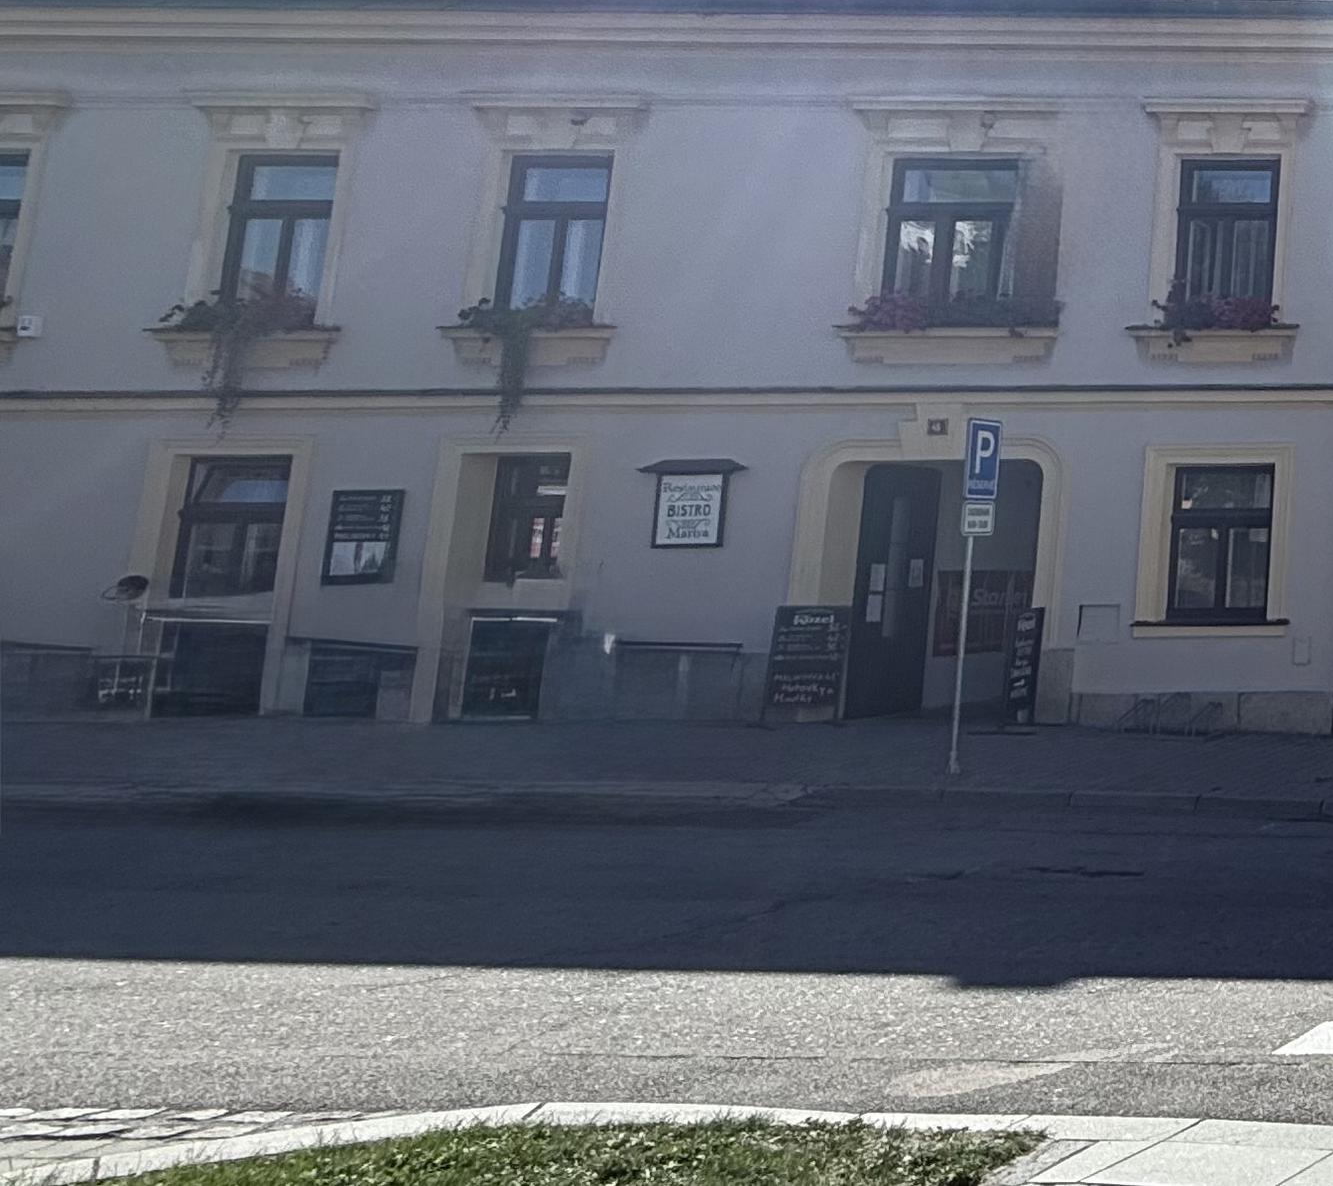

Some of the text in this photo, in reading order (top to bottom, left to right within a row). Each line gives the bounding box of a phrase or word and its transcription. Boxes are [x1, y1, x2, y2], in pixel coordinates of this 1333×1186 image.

[975, 429, 995, 474] P
[667, 504, 711, 517] BISTRO
[793, 615, 834, 625] Kozel
